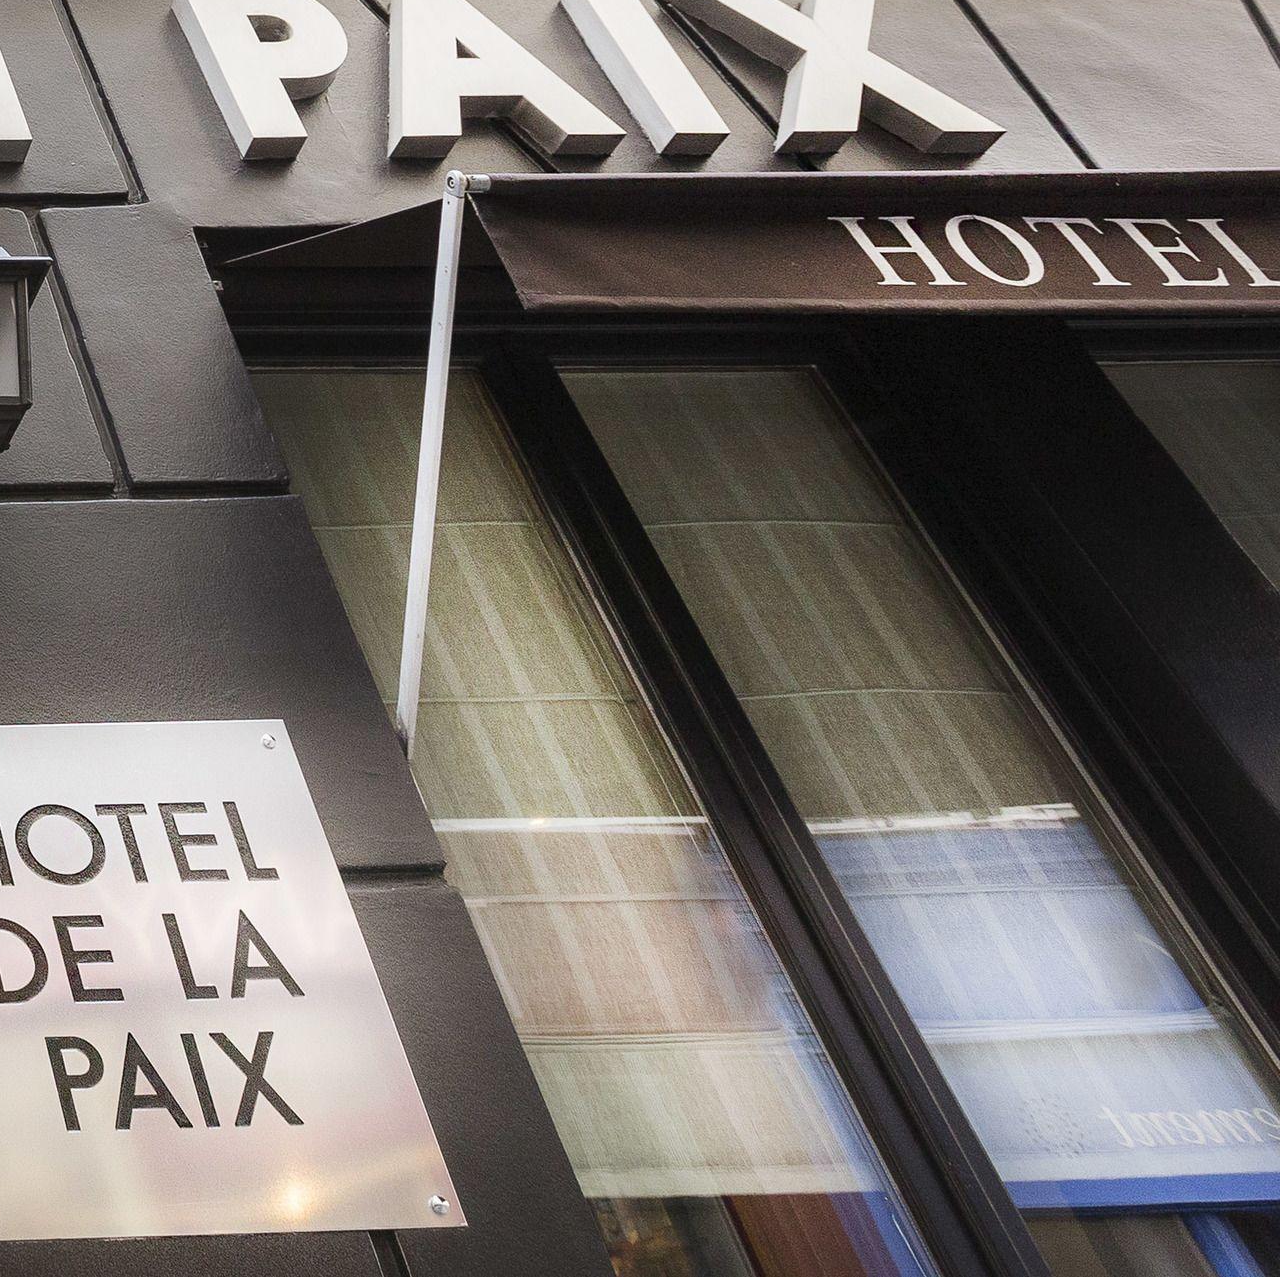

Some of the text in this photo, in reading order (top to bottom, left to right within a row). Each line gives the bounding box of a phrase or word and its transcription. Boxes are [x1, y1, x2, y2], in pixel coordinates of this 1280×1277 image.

[827, 214, 1280, 287] HOTEL
[161, 910, 306, 1000] LA
[44, 1031, 305, 1132] PAIX
